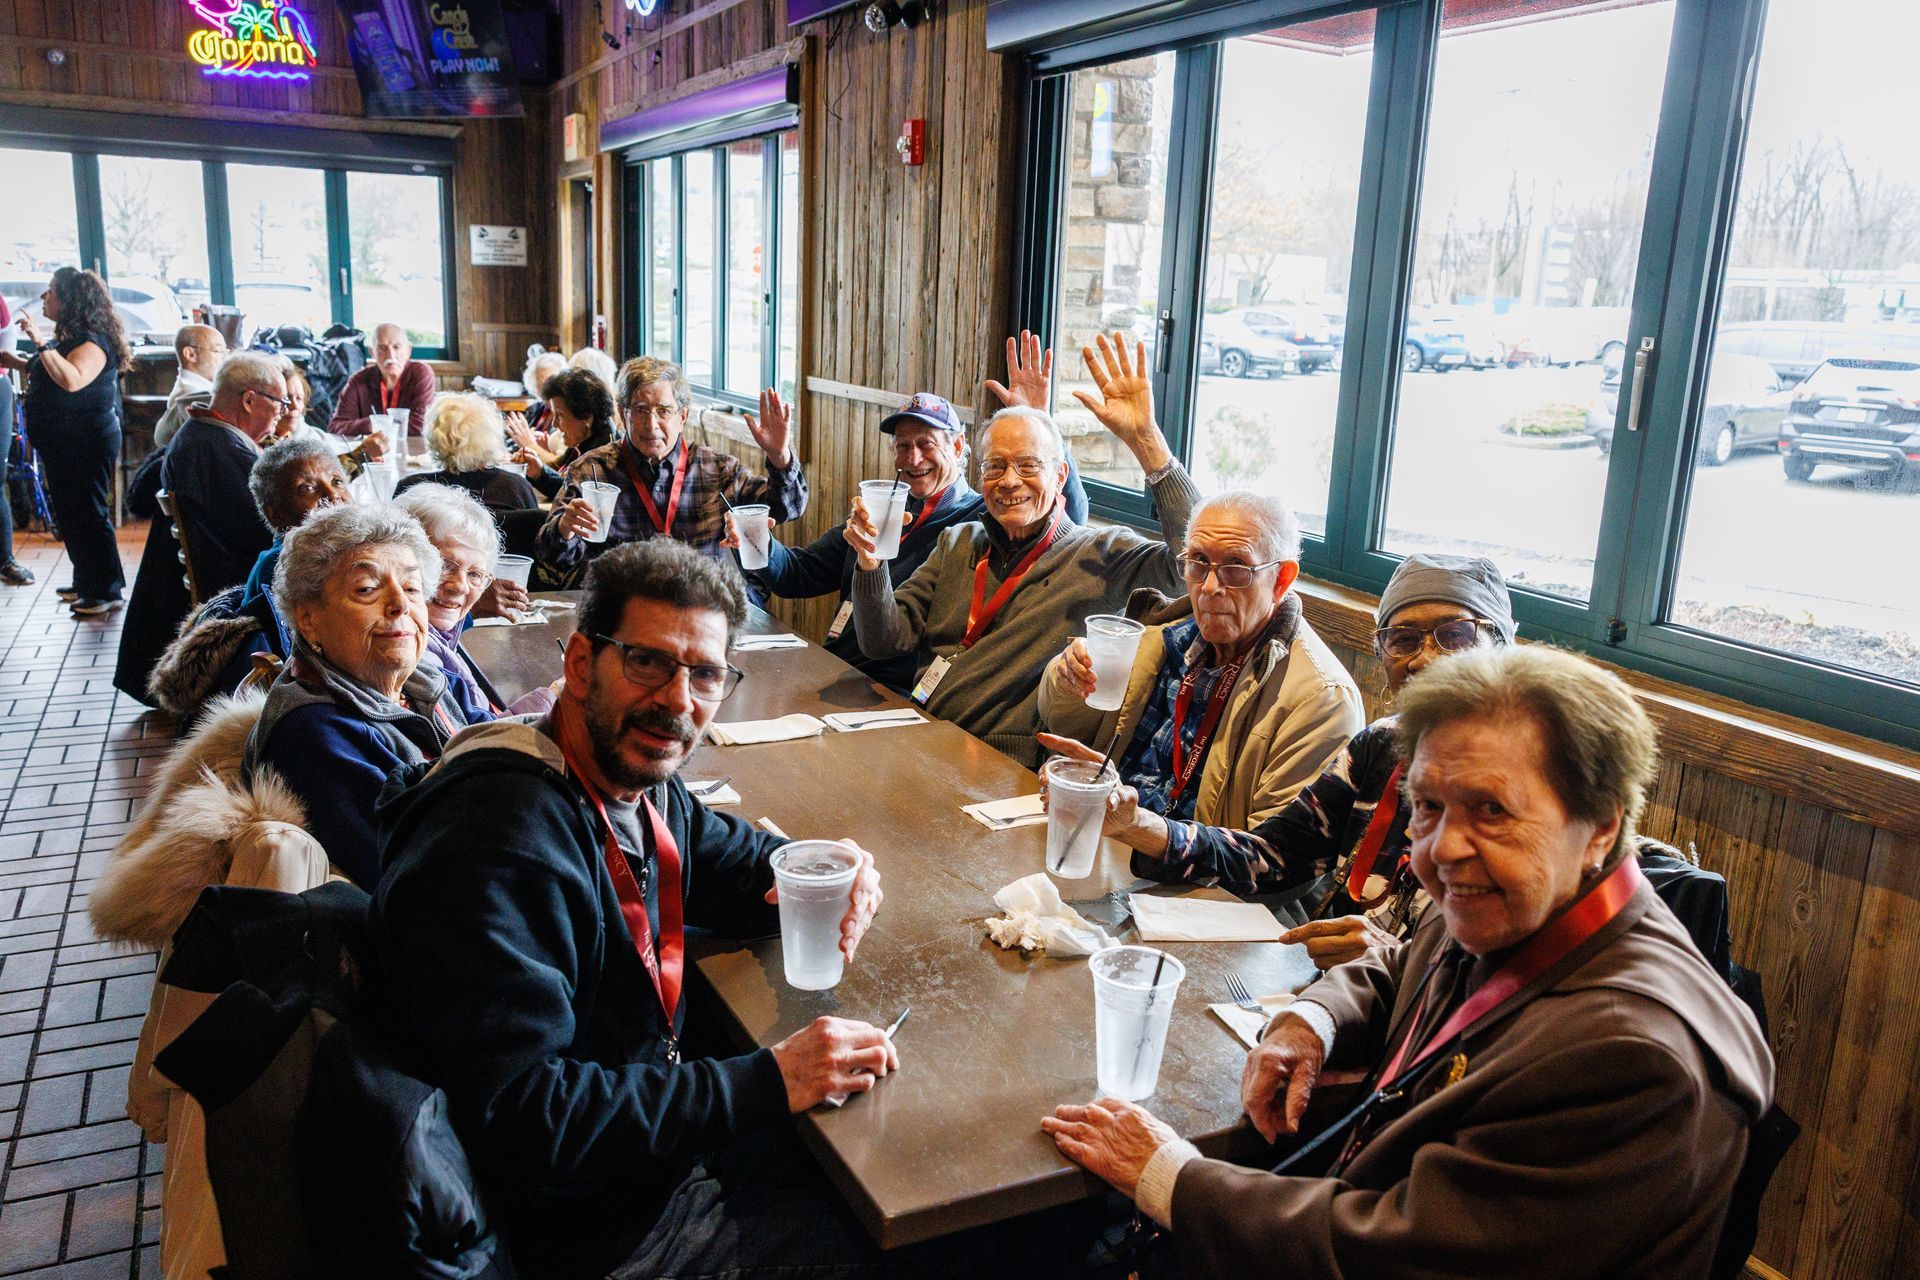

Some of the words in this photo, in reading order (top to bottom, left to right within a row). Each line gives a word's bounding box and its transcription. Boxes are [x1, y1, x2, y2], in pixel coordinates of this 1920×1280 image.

[188, 30, 305, 69] Corona
[430, 59, 464, 74] PLAY
[465, 57, 500, 73] NOW!
[1219, 663, 1241, 702] REGENCY
[1184, 744, 1203, 781] REGENCY
